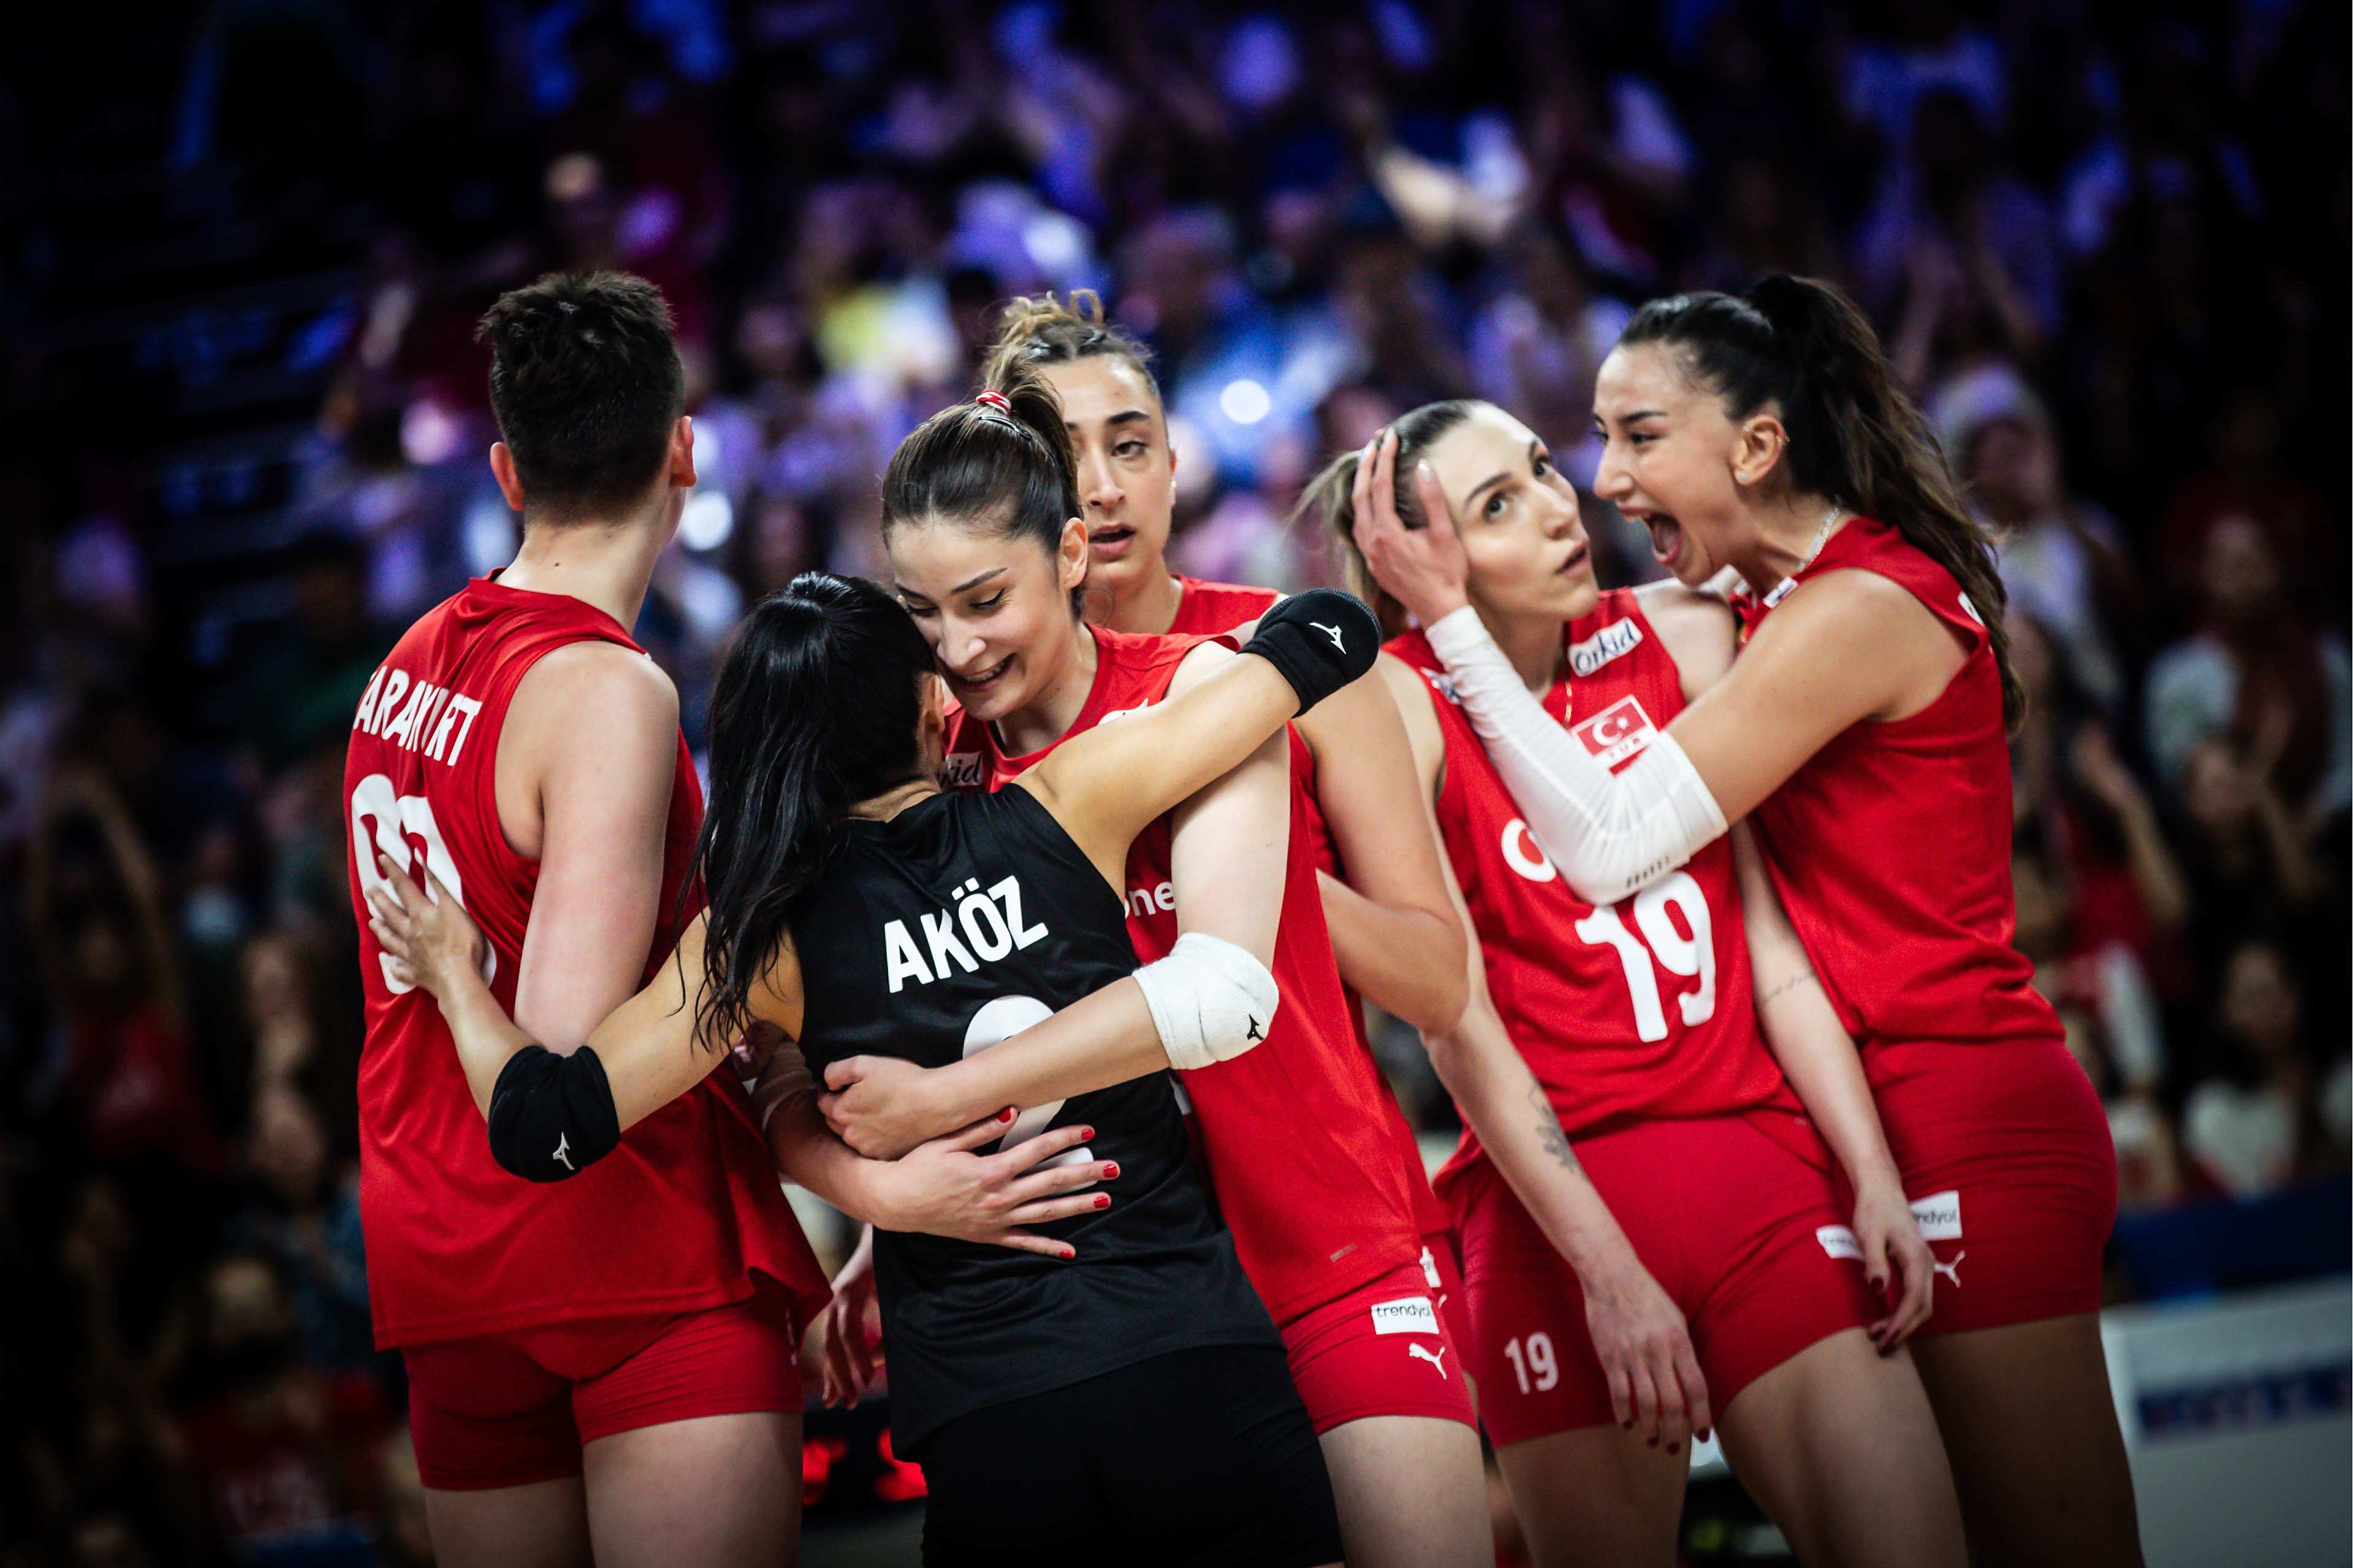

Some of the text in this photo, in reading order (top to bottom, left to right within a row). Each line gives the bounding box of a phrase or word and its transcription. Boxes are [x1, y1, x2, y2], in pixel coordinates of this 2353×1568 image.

[884, 875, 1049, 993] AKÖZ
[1124, 881, 1176, 918] ne
[1575, 870, 1716, 1043] 19
[1503, 1331, 1560, 1395] 19
